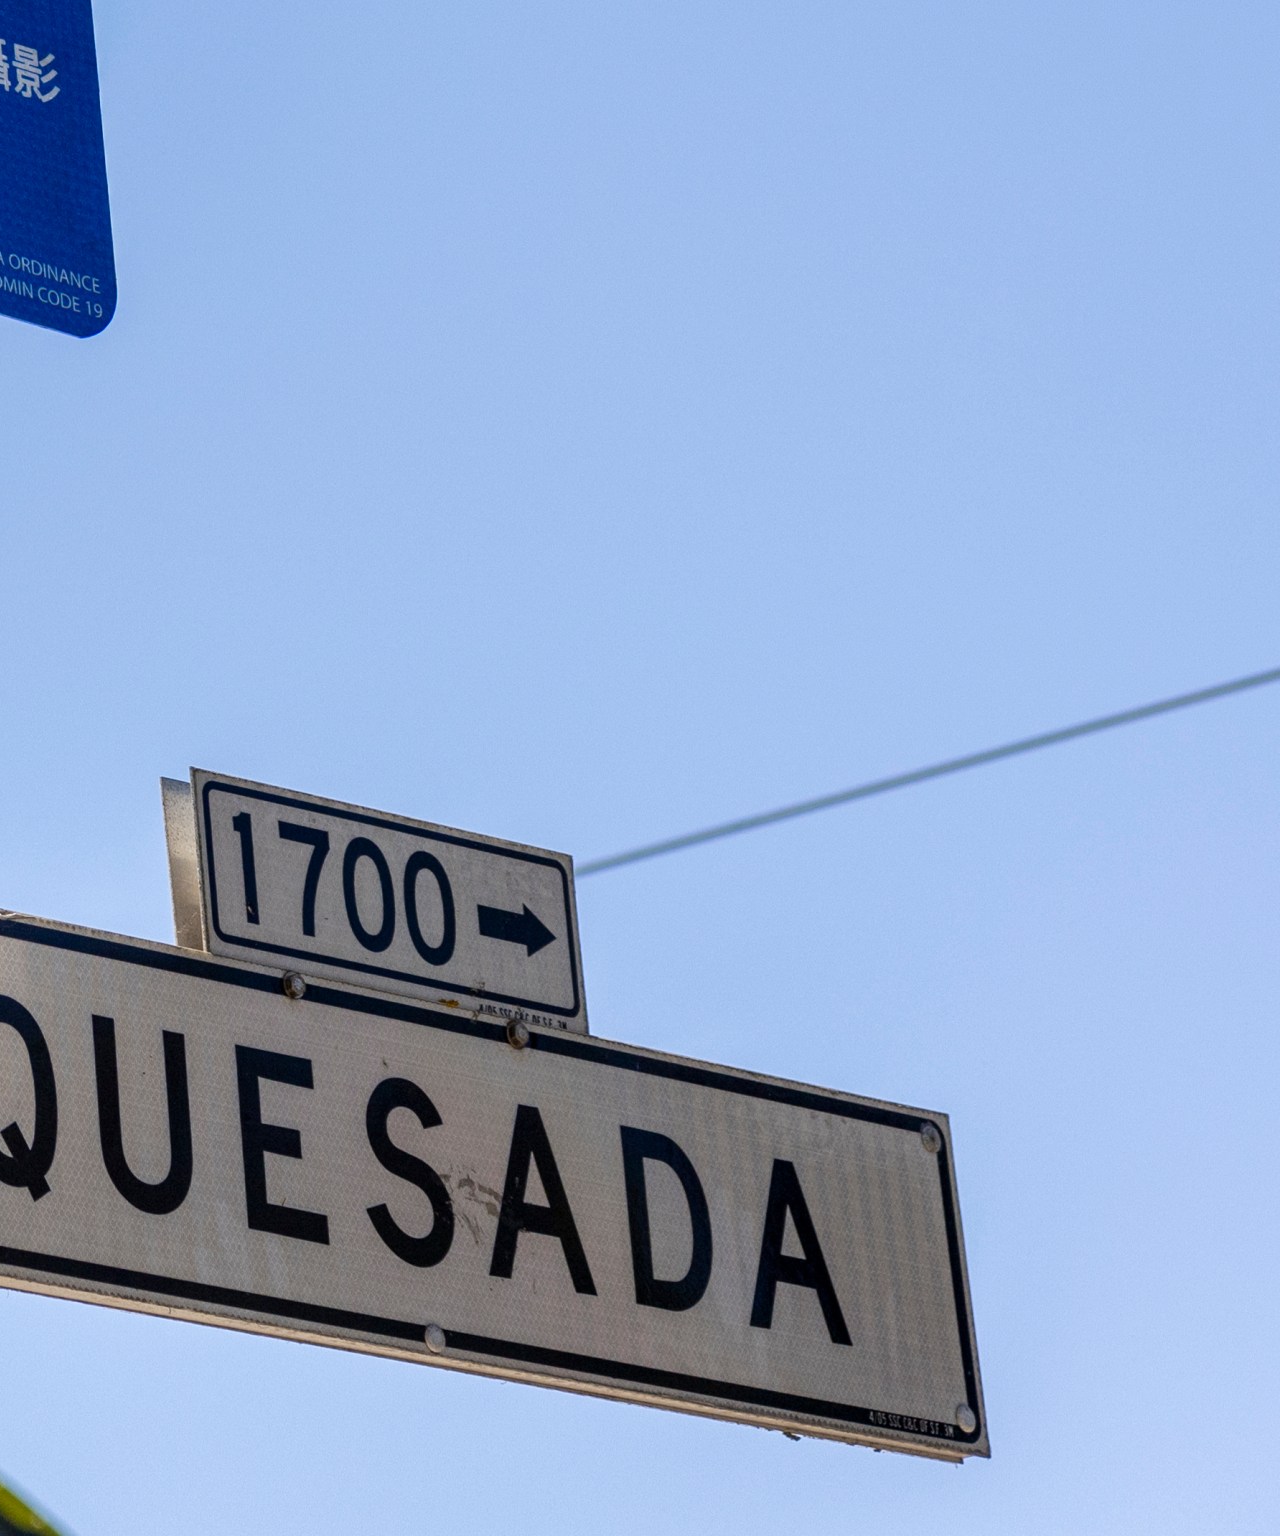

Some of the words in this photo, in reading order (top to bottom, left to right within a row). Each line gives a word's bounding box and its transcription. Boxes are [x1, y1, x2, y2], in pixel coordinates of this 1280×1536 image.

[8, 253, 101, 294] ORDINANCE
[37, 287, 81, 313] CODE
[85, 301, 103, 319] 19
[232, 810, 457, 967] 1700
